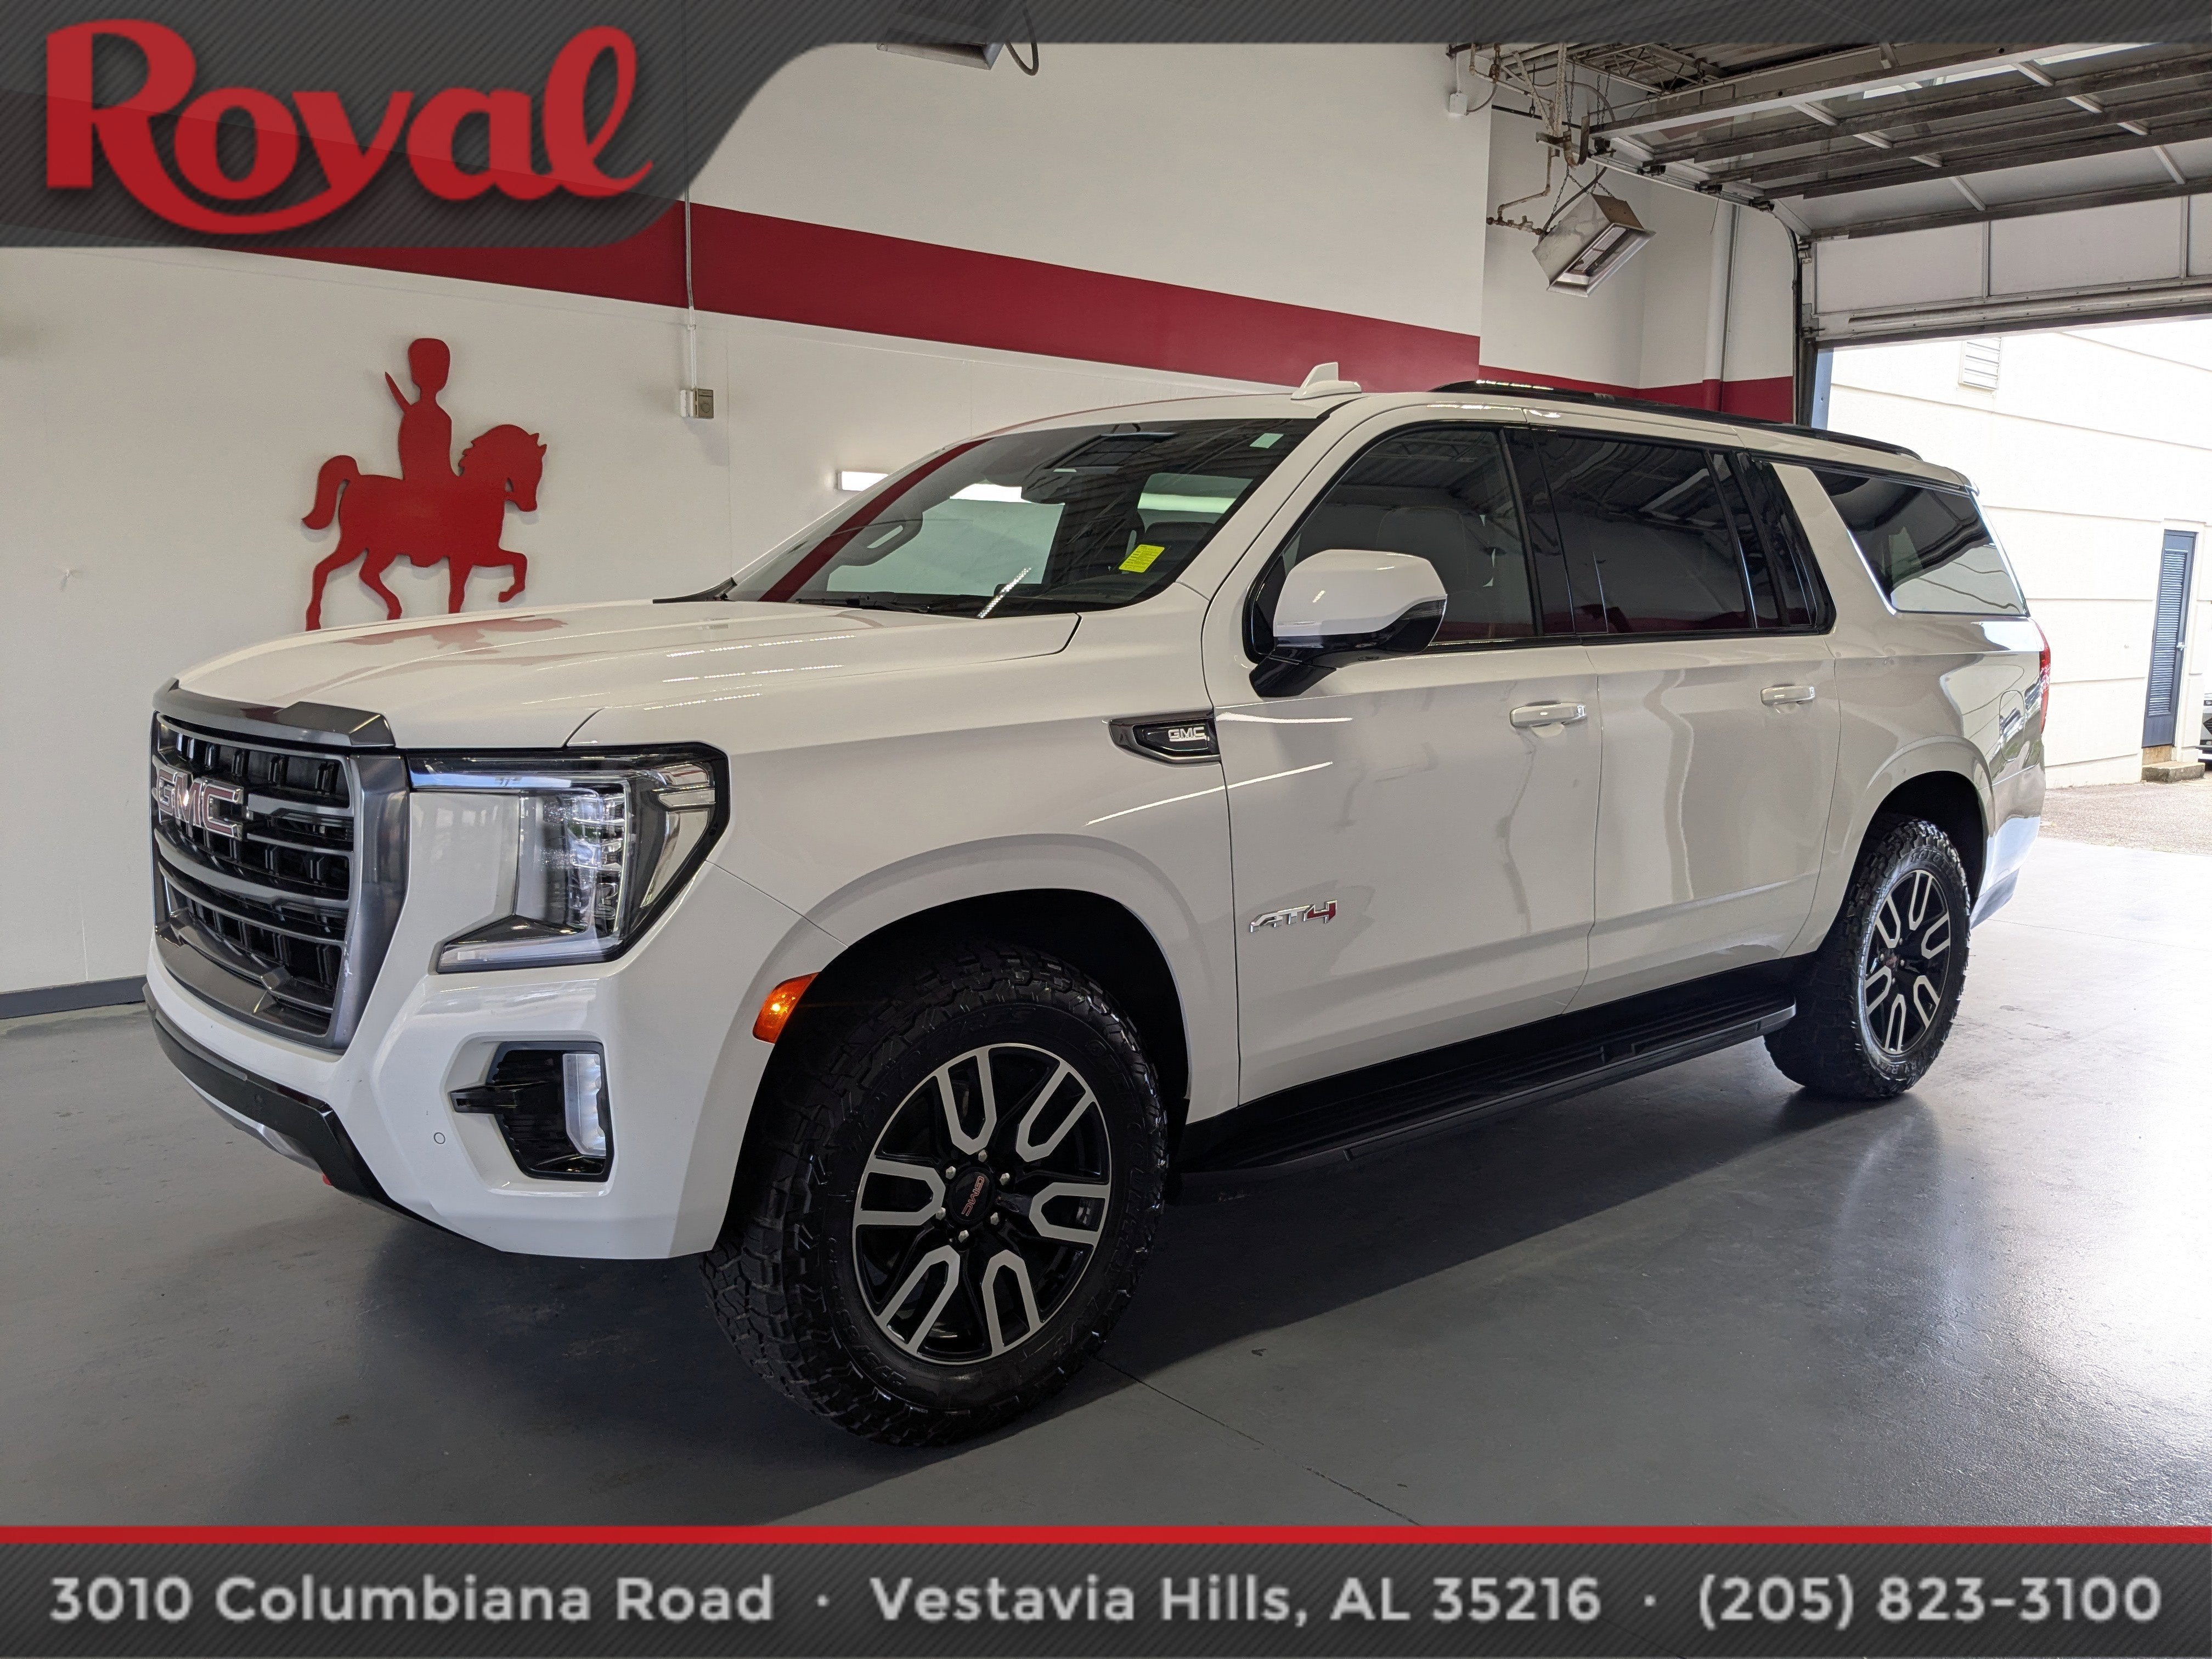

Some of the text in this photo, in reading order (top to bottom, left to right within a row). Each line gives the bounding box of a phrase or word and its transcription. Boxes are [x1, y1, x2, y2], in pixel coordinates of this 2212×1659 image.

[1168, 726, 1206, 740] GMC
[157, 768, 243, 841] GMC
[1249, 899, 1338, 933] AT4
[961, 1175, 985, 1217] GMC
